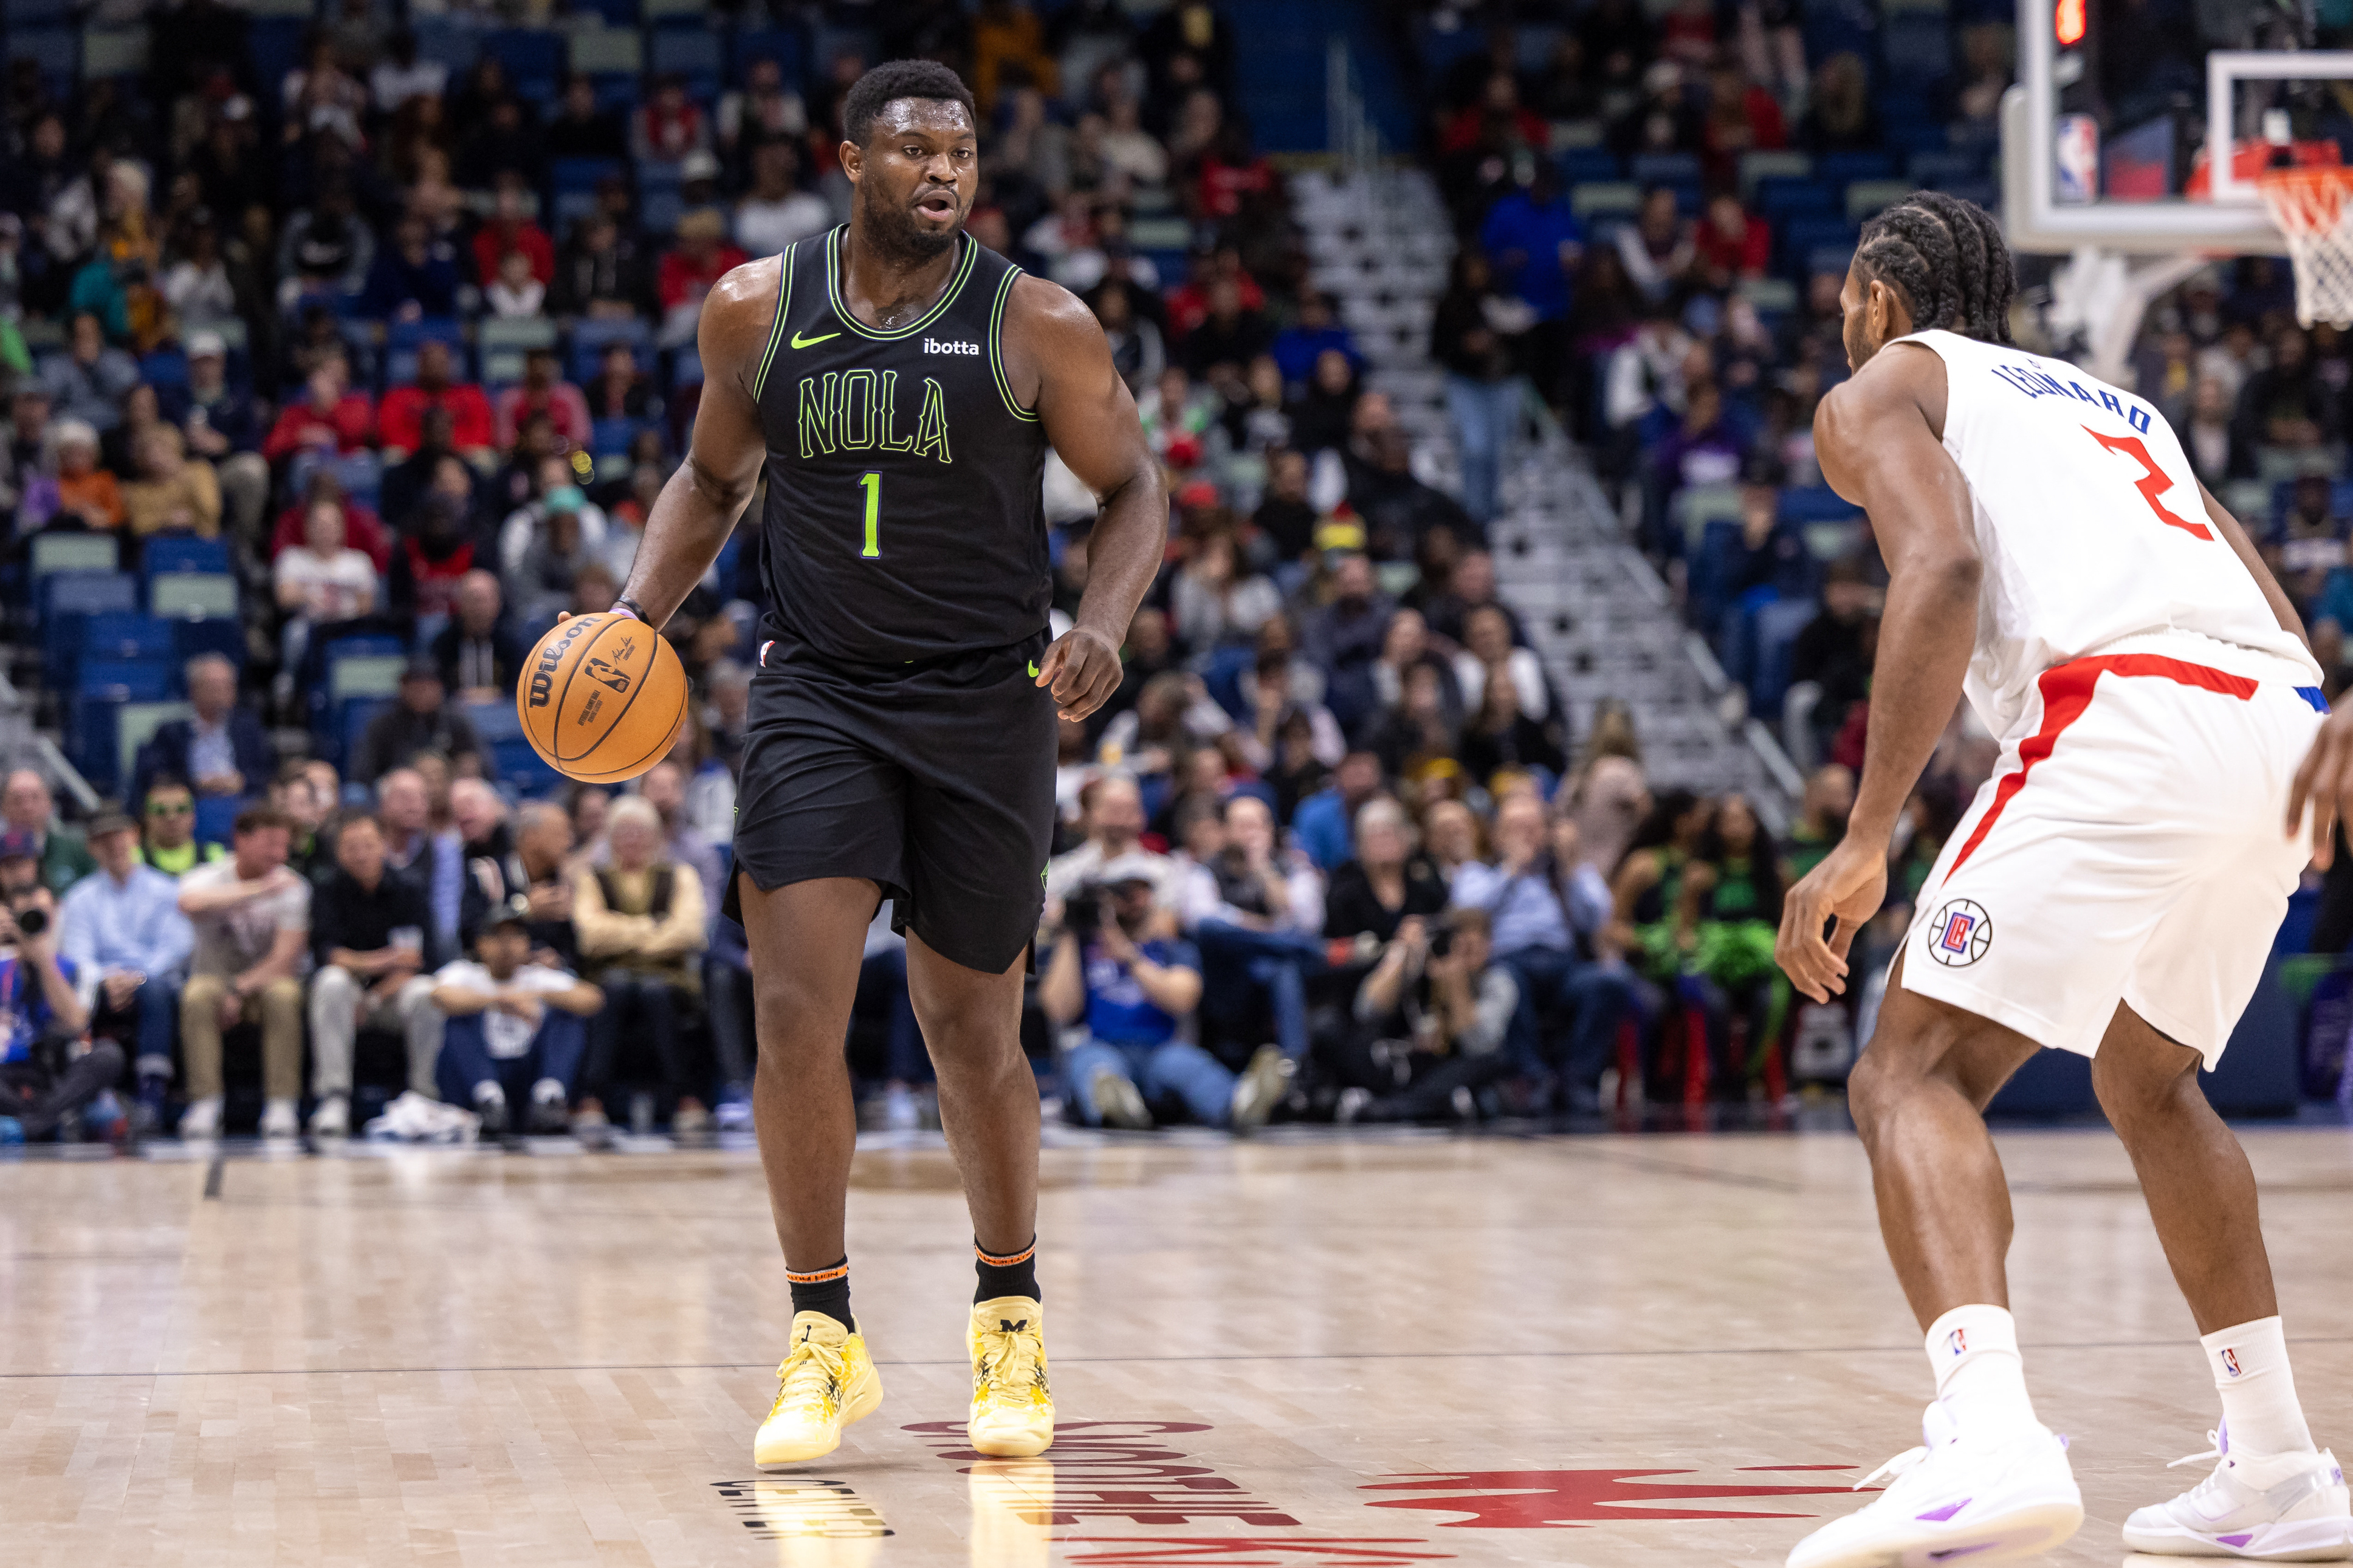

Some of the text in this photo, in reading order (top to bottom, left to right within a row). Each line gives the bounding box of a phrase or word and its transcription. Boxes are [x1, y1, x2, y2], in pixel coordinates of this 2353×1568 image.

[924, 338, 980, 355] ibotta
[798, 369, 952, 464] NOLA
[1991, 365, 2151, 436] LEONARD
[857, 470, 883, 560] 1
[2079, 423, 2215, 542] 2
[529, 616, 603, 708] Wilson
[709, 1479, 896, 1541] CENTER
